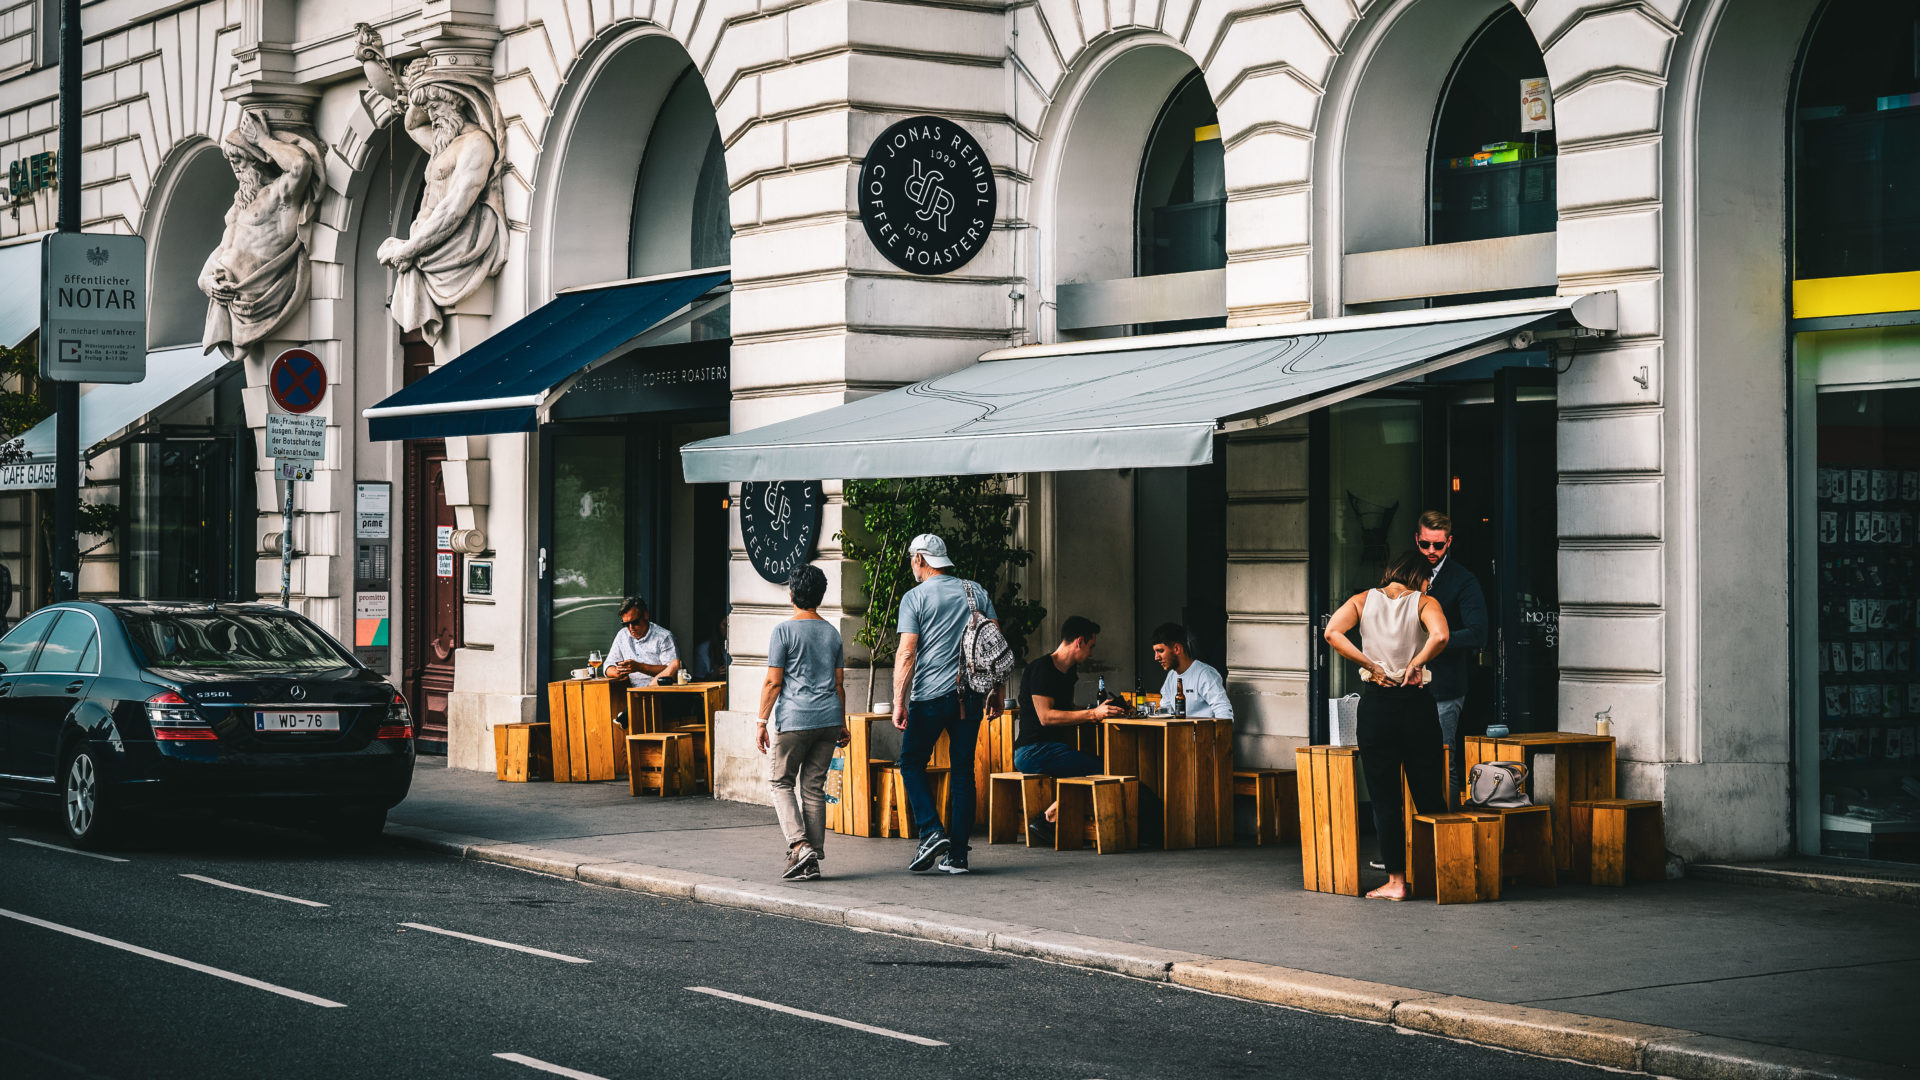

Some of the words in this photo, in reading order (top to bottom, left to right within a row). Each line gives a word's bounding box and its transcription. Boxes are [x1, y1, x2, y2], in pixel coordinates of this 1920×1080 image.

[886, 125, 941, 158] JONAS
[950, 134, 989, 207] REINDL
[930, 149, 956, 168] 1090
[870, 164, 900, 247] COFFEE
[905, 217, 985, 266] ROASTERS
[903, 222, 929, 242] 1070
[64, 274, 131, 286] öffentlicher
[58, 287, 136, 310] NOTAR
[682, 365, 727, 383] ROASTERS
[272, 436, 282, 444] der
[282, 437, 311, 446] Botschaft
[311, 439, 321, 447] des
[294, 428, 323, 438] Fahrzeuge
[273, 447, 302, 456] Sultanats
[302, 448, 320, 457] Oman
[3, 466, 25, 485] CAFE
[27, 464, 57, 484] GLASE
[763, 524, 810, 574] ROASTERS
[279, 714, 323, 728] WD-76
